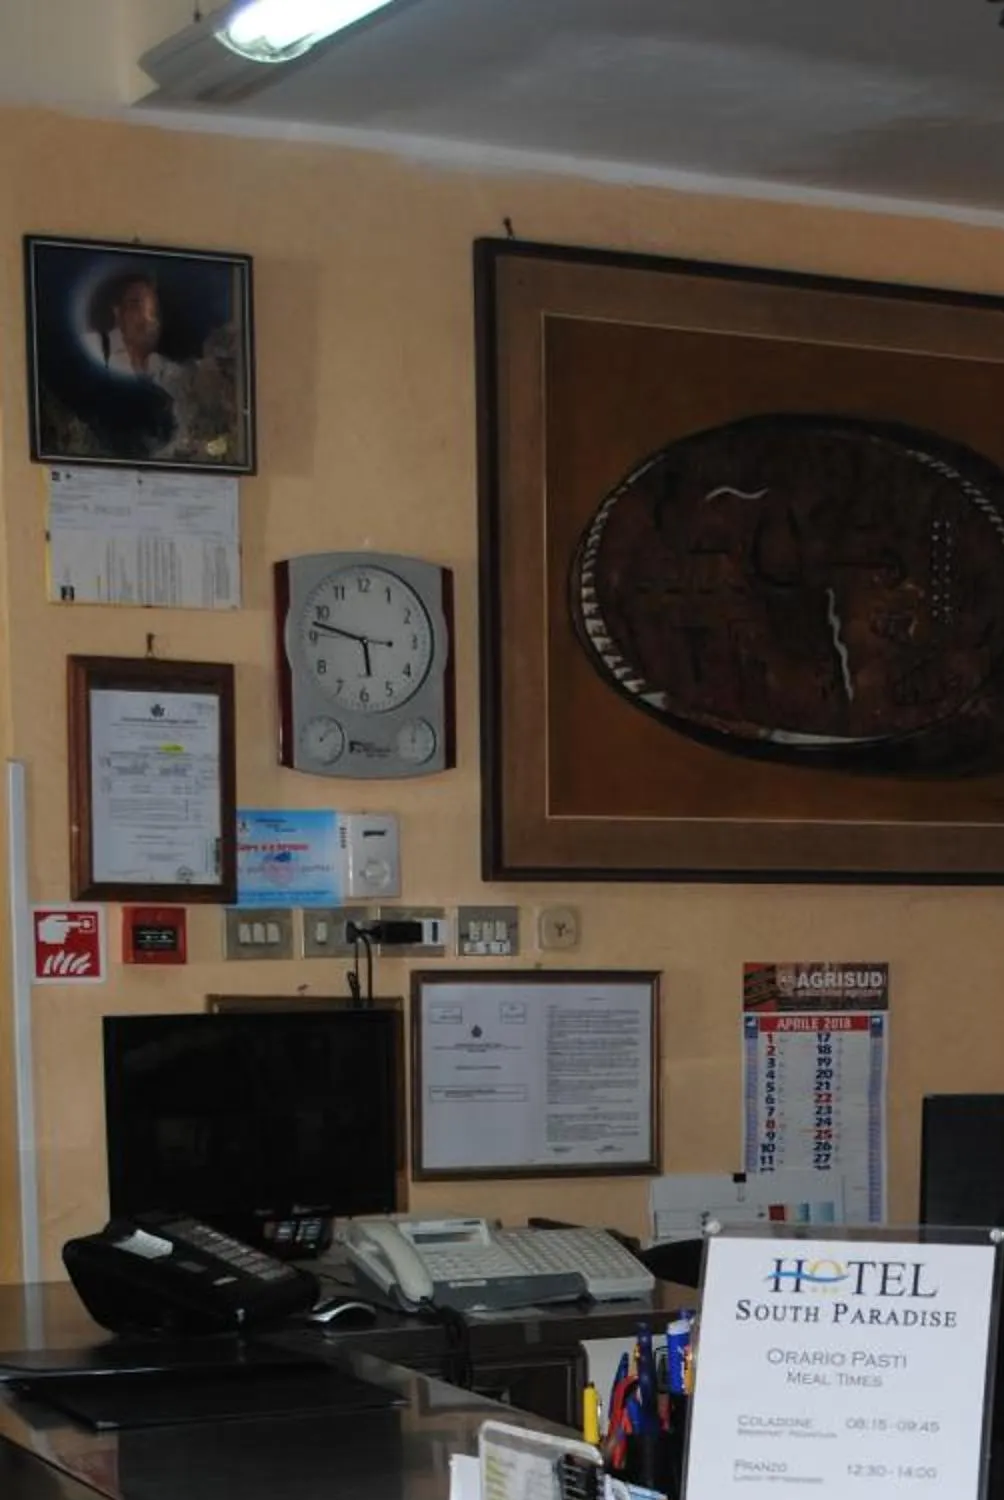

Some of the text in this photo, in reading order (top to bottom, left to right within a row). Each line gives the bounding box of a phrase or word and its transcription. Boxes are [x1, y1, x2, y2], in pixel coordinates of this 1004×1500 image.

[358, 578, 371, 593] 12
[333, 585, 345, 600] 11
[385, 587, 391, 604] 1
[315, 605, 330, 621] 10
[403, 608, 411, 624] 2
[317, 659, 327, 675] 8
[402, 662, 411, 678] 4
[335, 678, 344, 694] 7
[385, 681, 394, 697] 5
[359, 686, 369, 702] 6
[797, 970, 884, 989] AGRISUD
[775, 1017, 820, 1031] APRILE
[767, 1033, 774, 1045] 1
[816, 1031, 831, 1043] 17
[766, 1045, 776, 1056] 2
[816, 1043, 832, 1055] 18
[767, 1057, 776, 1069] 3
[816, 1056, 832, 1067] 19
[765, 1069, 776, 1080] 4
[815, 1068, 833, 1080] 20
[765, 1081, 775, 1093] 5
[814, 1081, 831, 1091] 21
[765, 1093, 775, 1105] 6
[813, 1092, 832, 1104] 22
[765, 1106, 776, 1117] 7
[814, 1105, 832, 1115] 23
[765, 1119, 776, 1129] 8
[814, 1116, 832, 1127] 24
[765, 1131, 775, 1141] 9
[813, 1129, 833, 1140] 25
[761, 1143, 776, 1153] 10
[812, 1141, 832, 1152] 26
[760, 1155, 774, 1166] 11
[813, 1153, 831, 1164] 27
[768, 1257, 938, 1299] HOTEL
[735, 1299, 958, 1328] SOUTH PARADISE
[767, 1347, 908, 1369] ORARIO PASTI
[786, 1371, 883, 1388] MEAL TIMES
